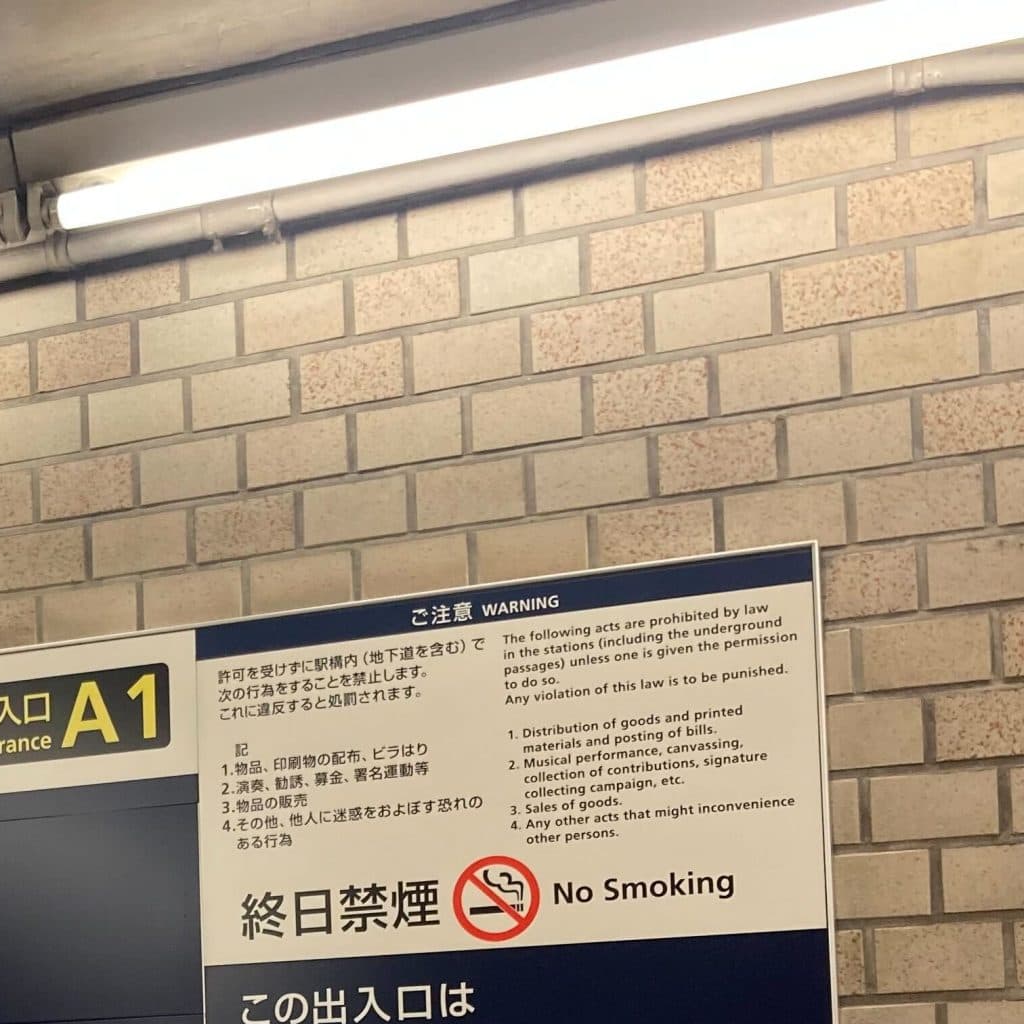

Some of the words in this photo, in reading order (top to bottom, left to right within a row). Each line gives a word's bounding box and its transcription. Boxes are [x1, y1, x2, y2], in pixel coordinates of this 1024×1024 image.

[412, 602, 472, 625] ご注意
[482, 595, 562, 618] WARNING
[503, 634, 525, 644] The
[530, 627, 590, 641] following
[596, 623, 620, 633] acts
[625, 620, 645, 629] are
[650, 609, 718, 629] prohibited
[724, 606, 740, 620] by
[745, 605, 768, 615] law
[504, 650, 514, 659] in
[520, 647, 539, 657] the
[544, 642, 594, 654] stations
[599, 633, 663, 649] (including
[668, 629, 688, 639] the
[694, 617, 782, 636] underground
[504, 658, 564, 677] passages)
[570, 655, 610, 666] unless
[615, 652, 638, 661] one
[643, 648, 652, 658] is
[657, 645, 693, 659] given
[698, 642, 719, 651] the
[724, 633, 797, 651] permission
[505, 681, 517, 689] to
[522, 677, 537, 687] do
[542, 677, 559, 685] so.
[505, 695, 529, 705] Any
[534, 688, 590, 701] violation
[595, 683, 608, 694] of
[613, 682, 636, 692] this
[641, 679, 664, 689] law
[669, 676, 678, 686] is
[683, 676, 696, 684] to
[702, 672, 717, 682] be
[722, 664, 787, 683] punished.
[61, 674, 156, 748] A1
[508, 729, 518, 740] 1.
[523, 723, 598, 738] Distribution
[603, 718, 616, 729] of
[621, 714, 660, 730] goods
[665, 710, 689, 723] and
[695, 705, 742, 722] printed
[235, 743, 248, 757] 記
[523, 738, 581, 753] materials
[586, 734, 609, 746] and
[615, 732, 663, 746] posting
[668, 727, 681, 738] of
[686, 725, 717, 736] bills.
[508, 759, 519, 770] 2.
[524, 754, 571, 768] Musical
[576, 748, 662, 765] performance,
[667, 740, 743, 754] canvassing,
[524, 770, 584, 783] collection
[590, 766, 602, 777] of
[608, 760, 699, 775] contributions,
[704, 753, 767, 767] signature
[525, 785, 585, 798] collecting
[590, 779, 656, 792] campaign,
[661, 776, 684, 785] etc.
[510, 820, 522, 831] 4.
[526, 819, 550, 829] Any
[555, 815, 589, 826] other
[594, 813, 619, 823] acts
[624, 810, 650, 820] that
[655, 805, 694, 818] might
[699, 798, 795, 813] inconvenience
[511, 806, 520, 815] 3.
[526, 802, 557, 814] Sales
[562, 799, 575, 810] of
[579, 796, 622, 811] goods.
[237, 833, 292, 849] ある行為
[527, 833, 560, 844] other
[565, 830, 618, 843] persons.
[554, 882, 593, 904] No
[604, 871, 734, 901] Smoking
[242, 880, 440, 940] 終日禁煙
